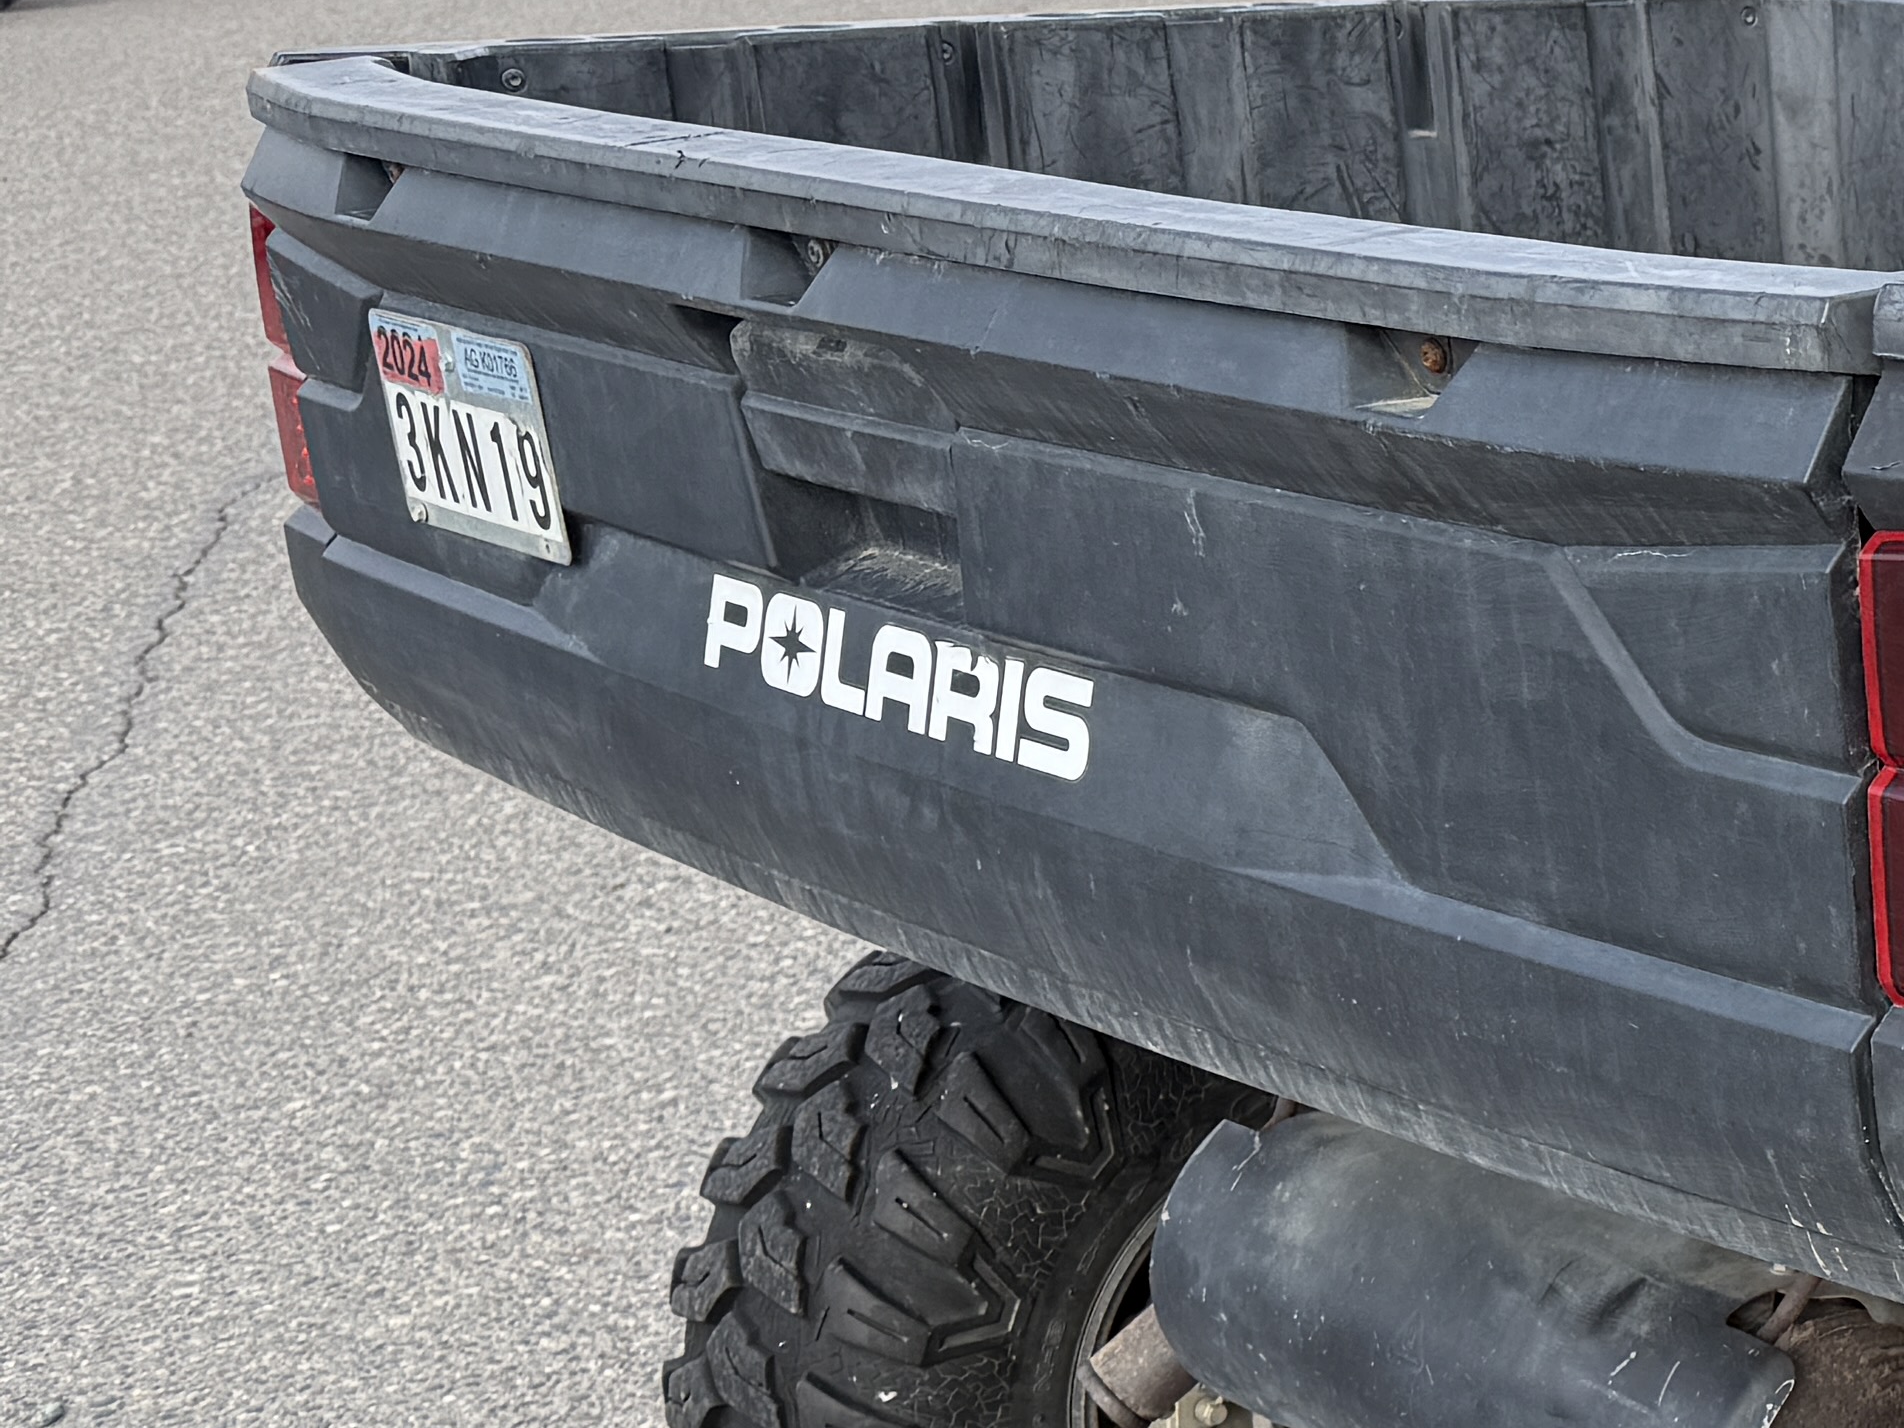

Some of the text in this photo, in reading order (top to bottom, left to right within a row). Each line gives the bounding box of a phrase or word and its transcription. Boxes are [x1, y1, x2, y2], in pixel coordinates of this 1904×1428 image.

[377, 325, 432, 388] 2024
[395, 391, 553, 532] 3KN19
[703, 573, 1094, 783] POLARIS
